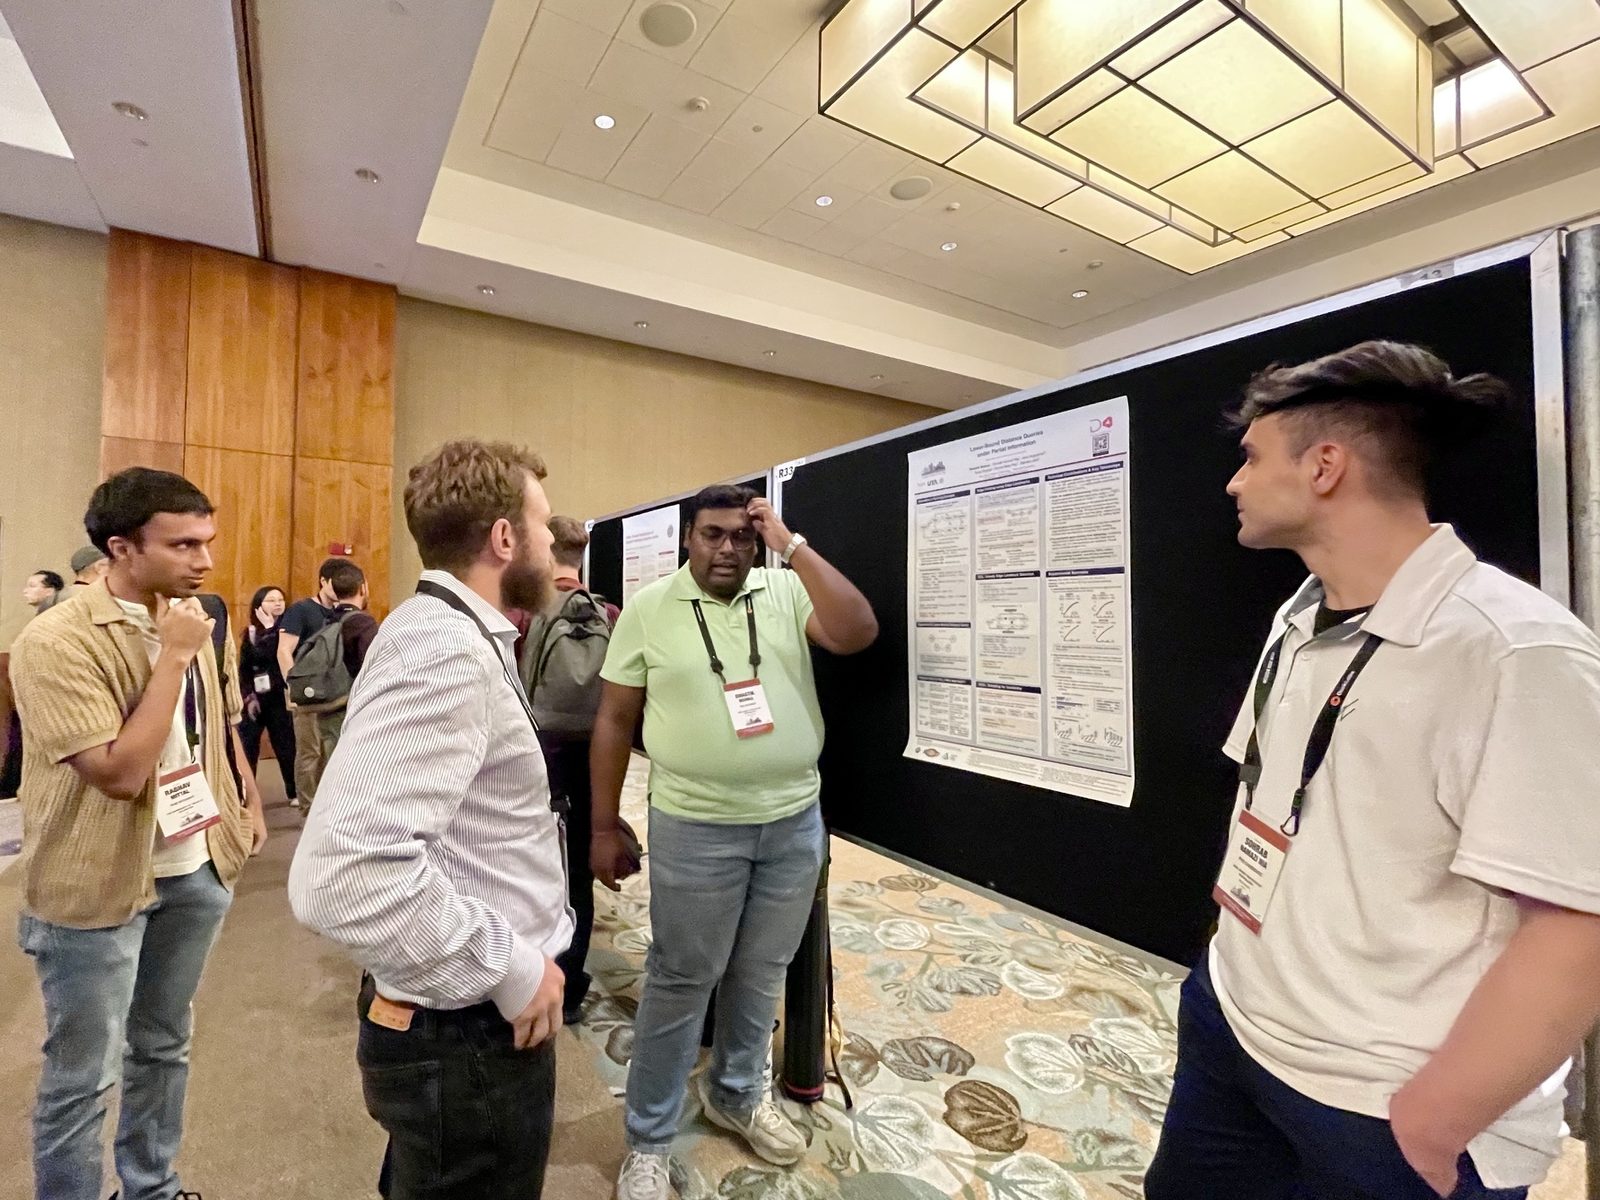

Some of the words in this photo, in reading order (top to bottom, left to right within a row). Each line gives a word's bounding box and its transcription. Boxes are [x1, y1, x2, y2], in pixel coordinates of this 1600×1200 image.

[779, 466, 794, 478] R33
[165, 782, 190, 796] RAGHAV
[1245, 837, 1268, 859] SOHRAB
